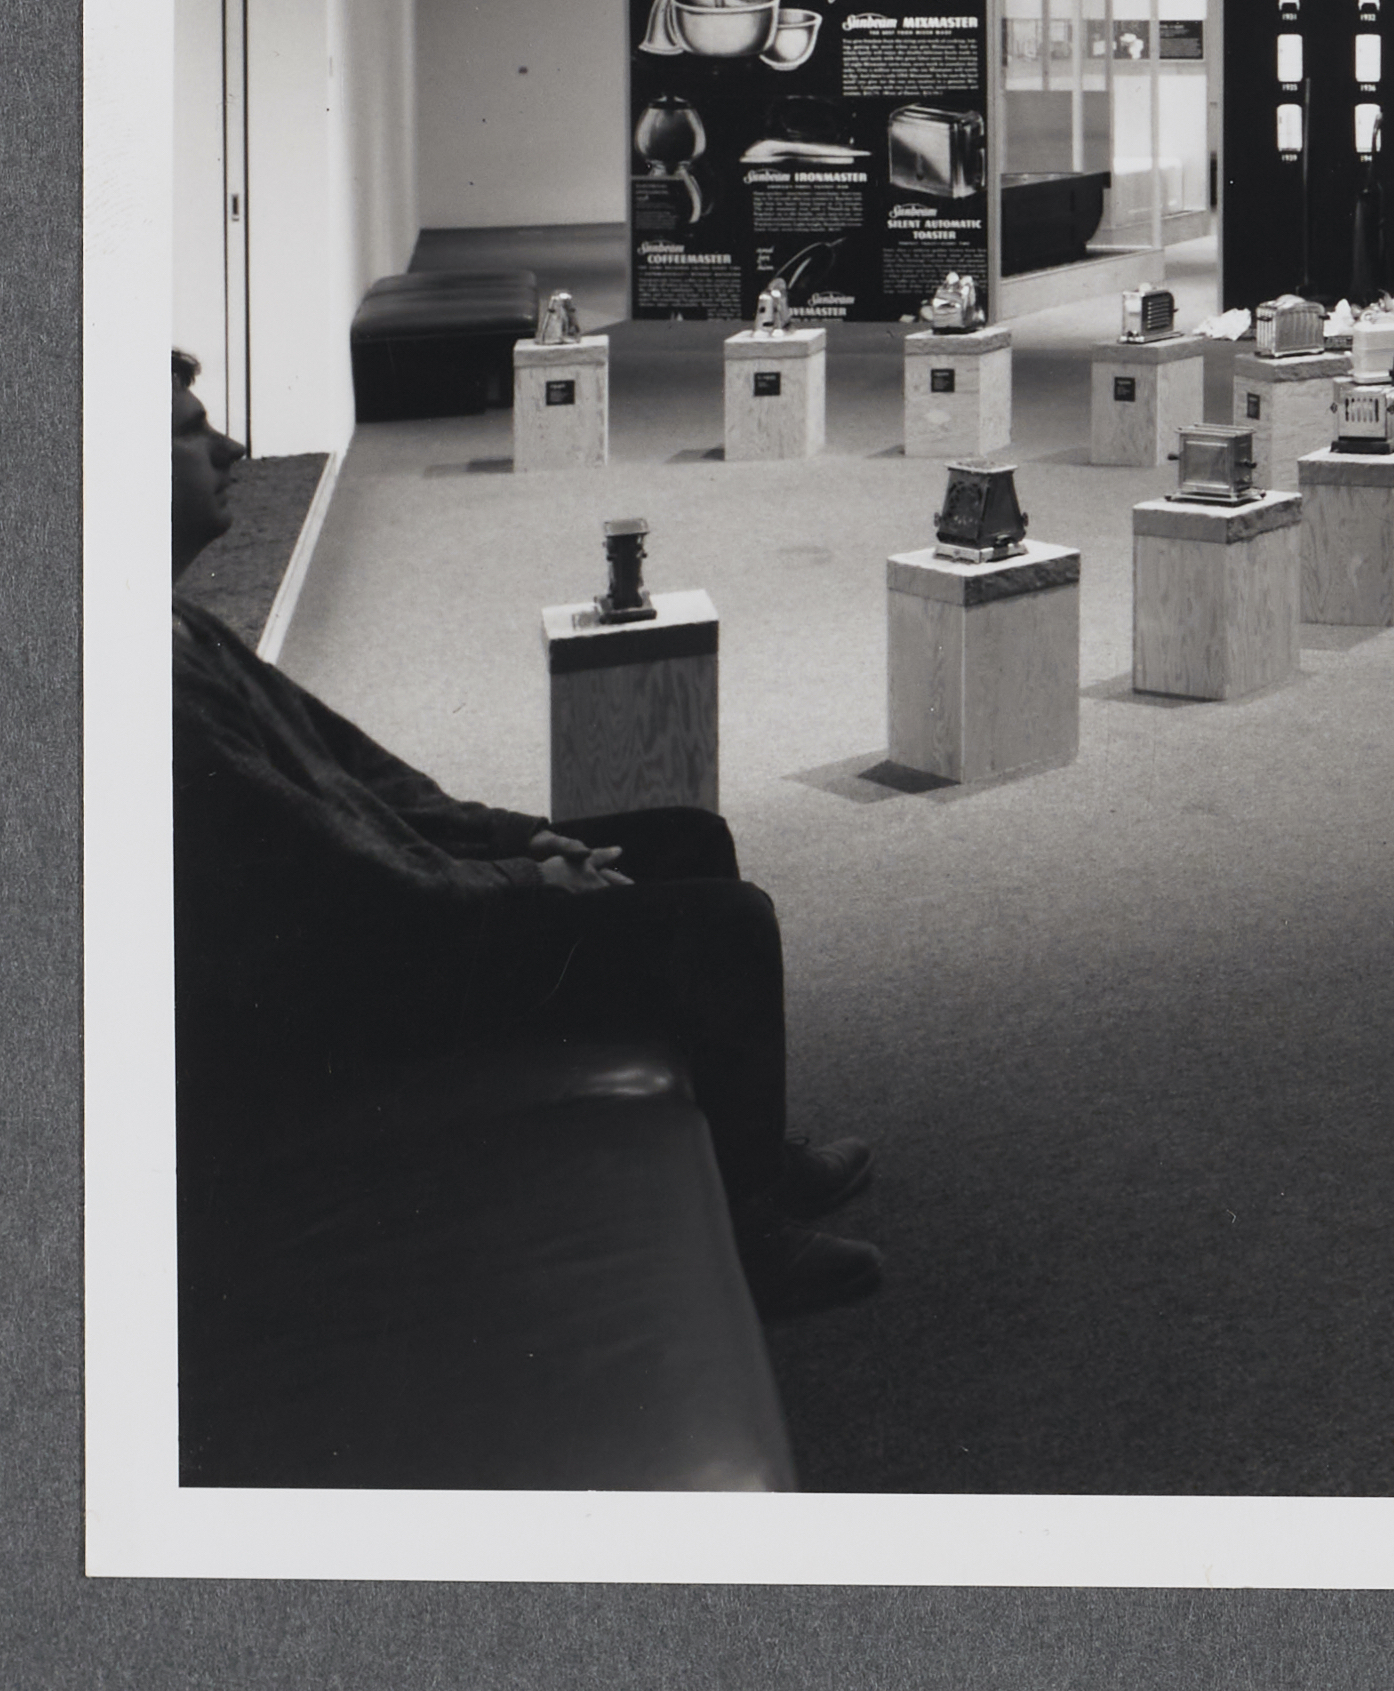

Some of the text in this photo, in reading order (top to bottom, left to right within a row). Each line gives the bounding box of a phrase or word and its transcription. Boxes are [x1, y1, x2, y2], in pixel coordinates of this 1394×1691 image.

[842, 12, 978, 31] Sunbeam MIXMASTER
[1360, 154, 1372, 162] 194
[743, 168, 867, 184] Sunbeam IRONMASTER
[889, 203, 938, 218] Sunbeam
[887, 220, 981, 229] SILENT AUTOMATIC
[912, 231, 957, 239] TOASTER
[637, 240, 685, 254] Sunbeam
[647, 254, 731, 264] COFFEEMASTER
[807, 291, 856, 307] Sunbeam
[788, 307, 847, 316] VEMASTER
